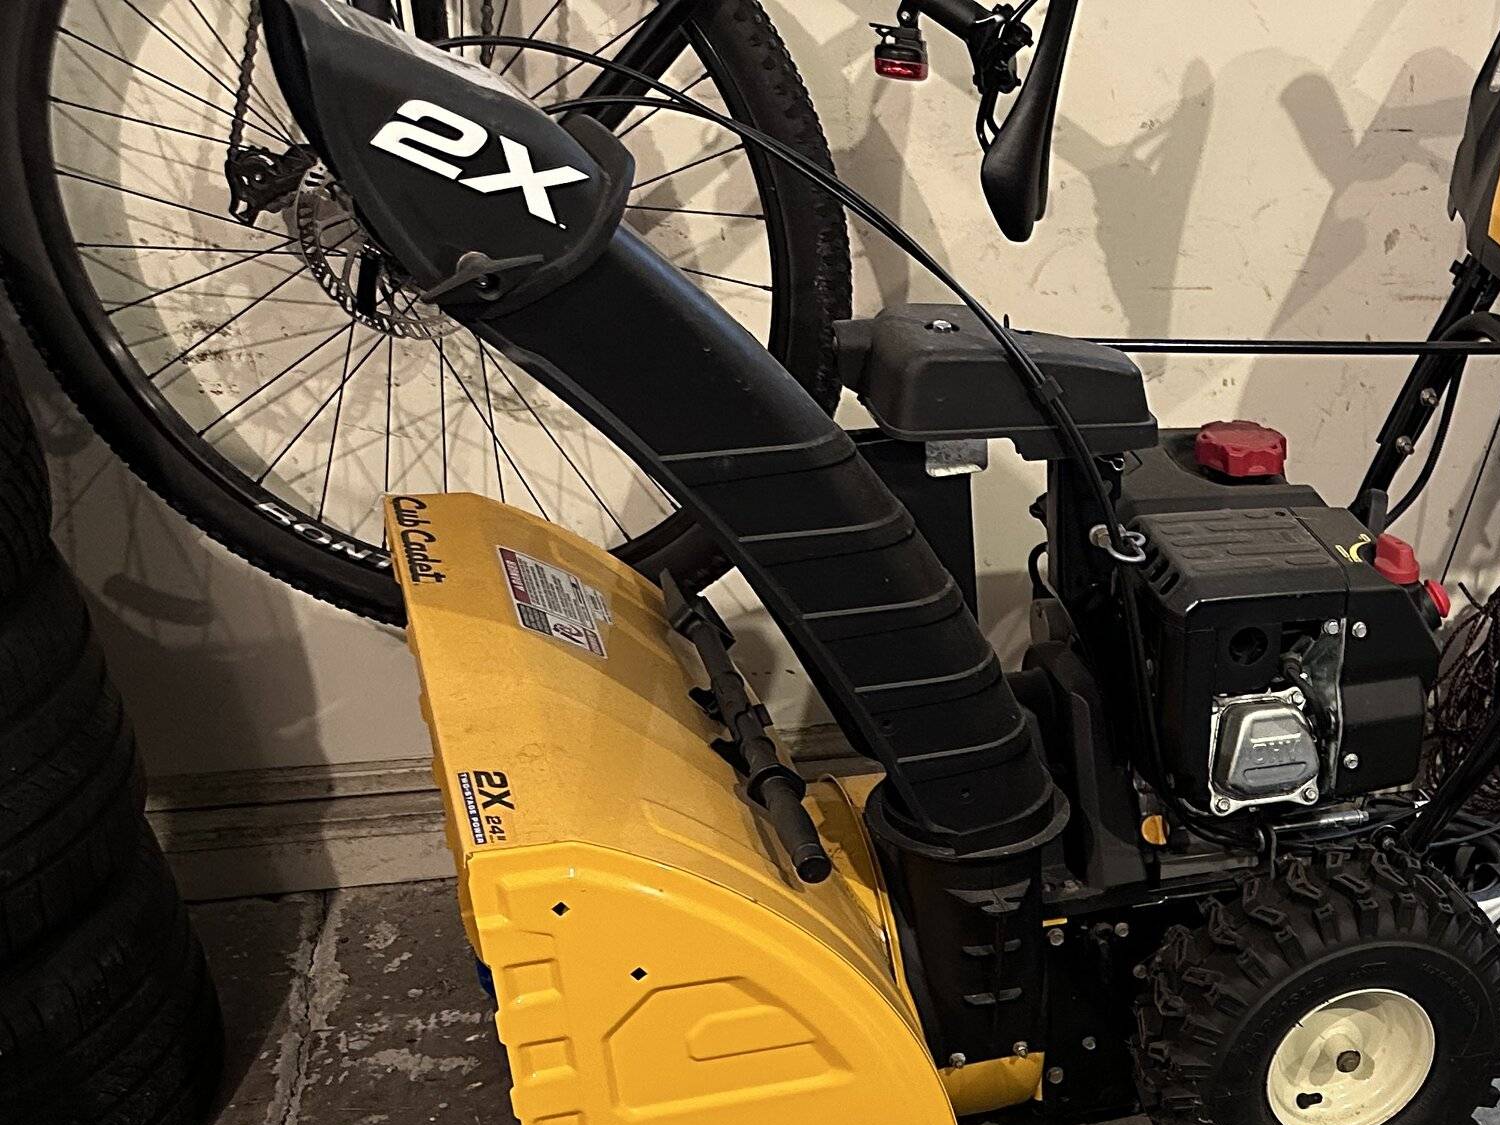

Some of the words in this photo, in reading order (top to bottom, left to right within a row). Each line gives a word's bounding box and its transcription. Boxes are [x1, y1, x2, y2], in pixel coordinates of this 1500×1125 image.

[370, 99, 591, 225] 2X
[392, 496, 431, 528] Cub
[401, 529, 447, 583] Cadet
[459, 773, 478, 815] TWO-STAGE
[470, 816, 485, 844] POWER
[473, 770, 516, 810] 2X
